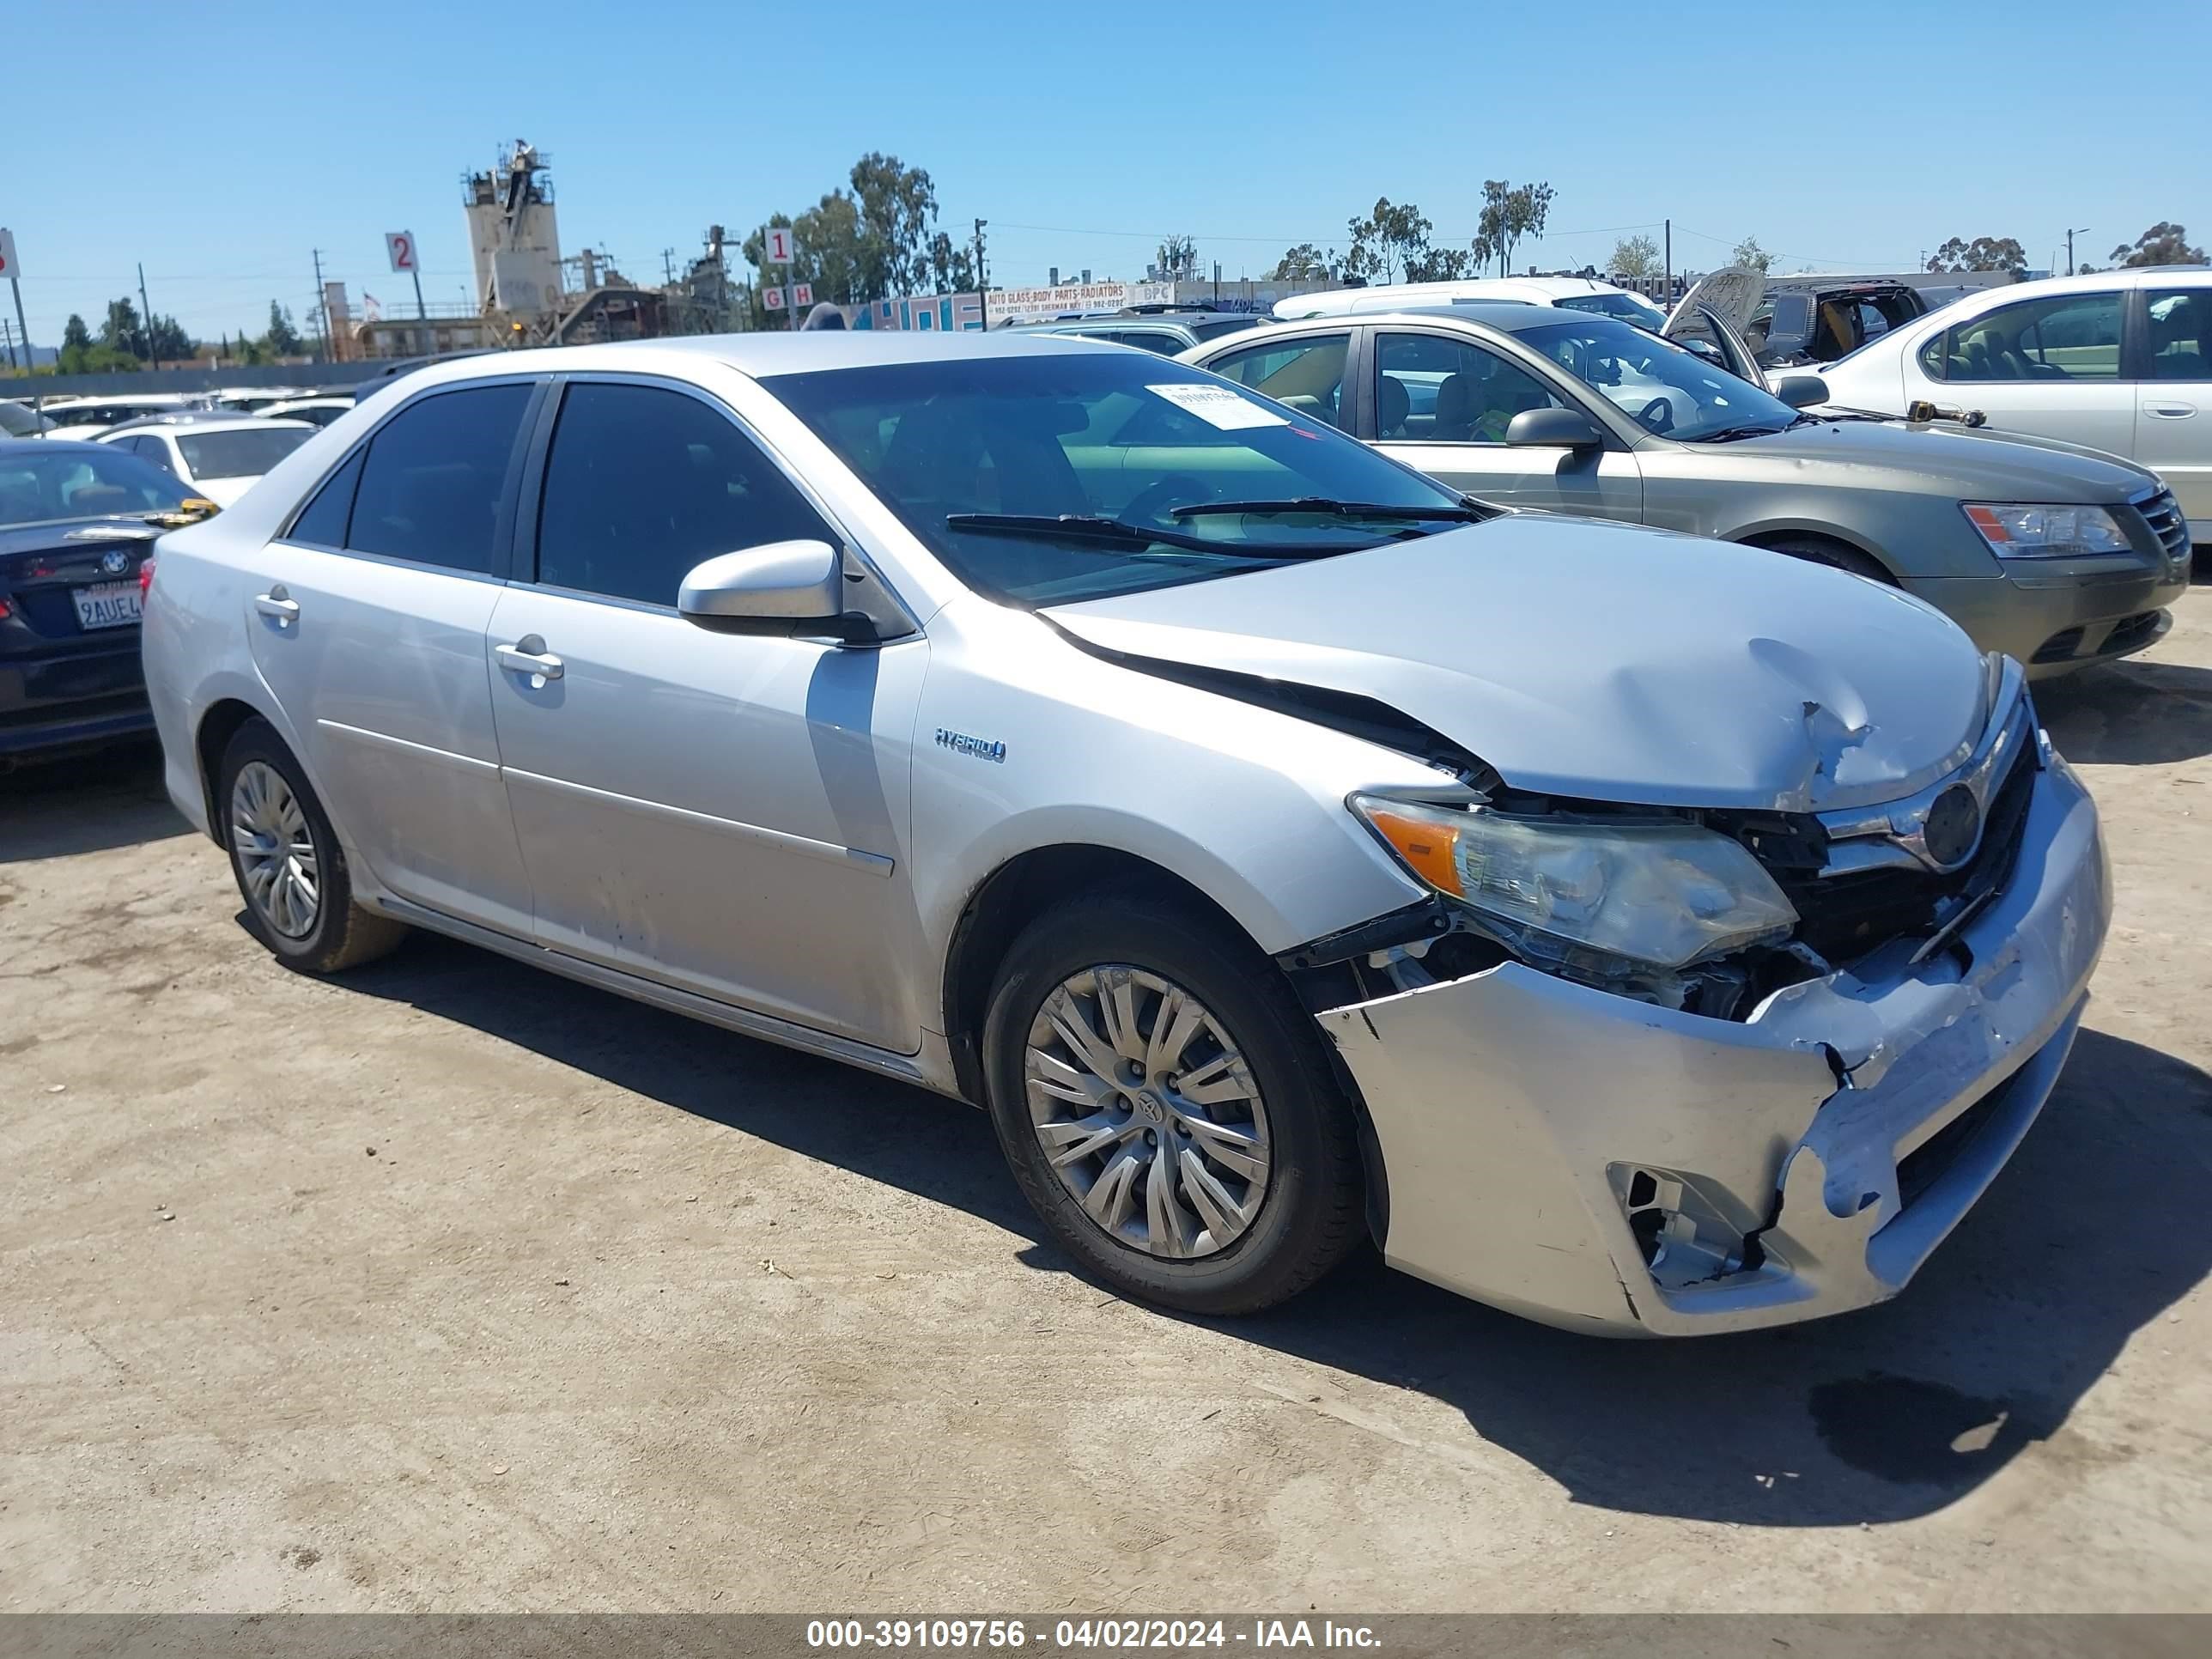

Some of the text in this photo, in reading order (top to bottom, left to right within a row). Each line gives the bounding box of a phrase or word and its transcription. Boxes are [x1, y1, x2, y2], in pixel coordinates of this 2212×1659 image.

[394, 237, 412, 267] 2
[773, 233, 787, 259] 1
[768, 289, 780, 307] G
[796, 287, 809, 304] H
[988, 293, 1006, 305] AUTO
[1144, 286, 1169, 301] BPC
[934, 726, 994, 756] HYBRID
